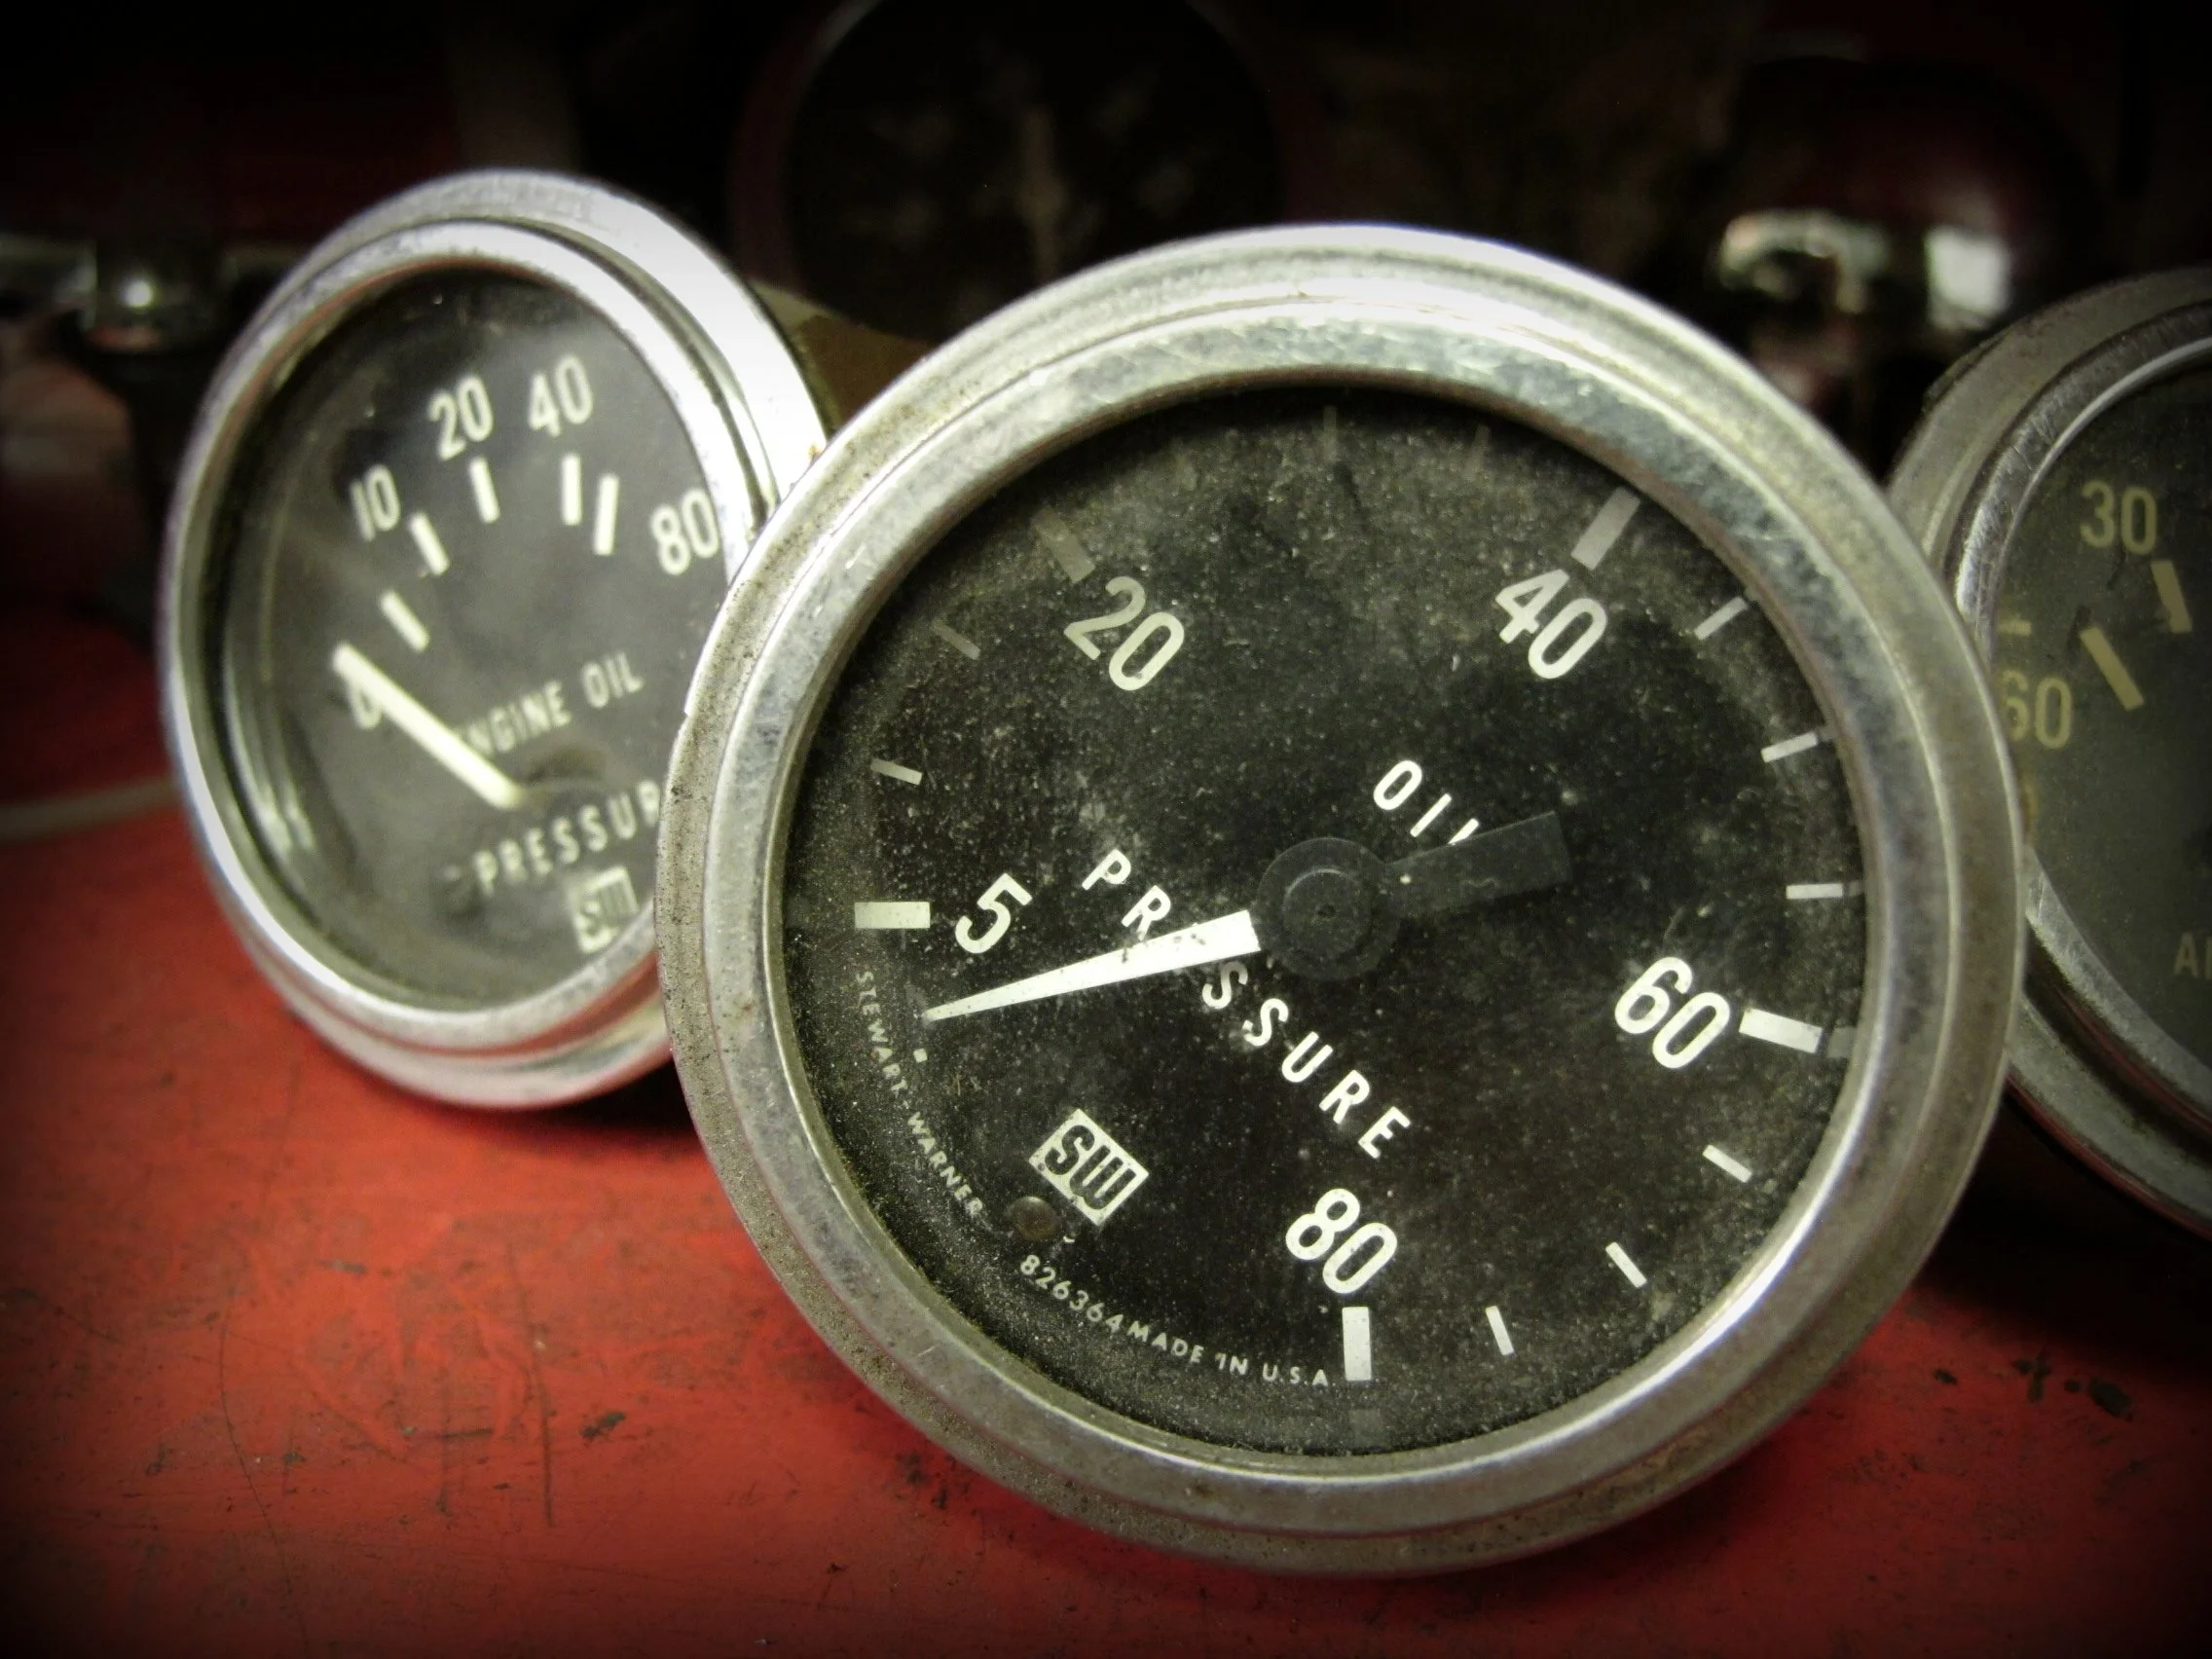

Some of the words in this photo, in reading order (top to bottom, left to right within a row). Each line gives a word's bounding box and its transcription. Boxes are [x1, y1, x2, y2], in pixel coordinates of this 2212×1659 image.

[428, 376, 493, 461] 20
[528, 355, 594, 438] 40
[350, 464, 401, 541] 10
[650, 489, 719, 575] 80
[2081, 480, 2158, 555] 30
[1063, 576, 1186, 691] 20
[1494, 569, 1607, 681] 40
[466, 681, 572, 755] NGINE
[582, 650, 645, 709] OIL
[2000, 668, 2073, 750] 60
[473, 779, 662, 898] PRESSUR
[954, 871, 1033, 954] 5
[1081, 848, 1412, 1160] PRSSURE
[1614, 956, 1730, 1069] 60
[1284, 1187, 1398, 1295] 80
[1019, 1254, 1123, 1334] 826364
[1126, 1320, 1204, 1364] MADE
